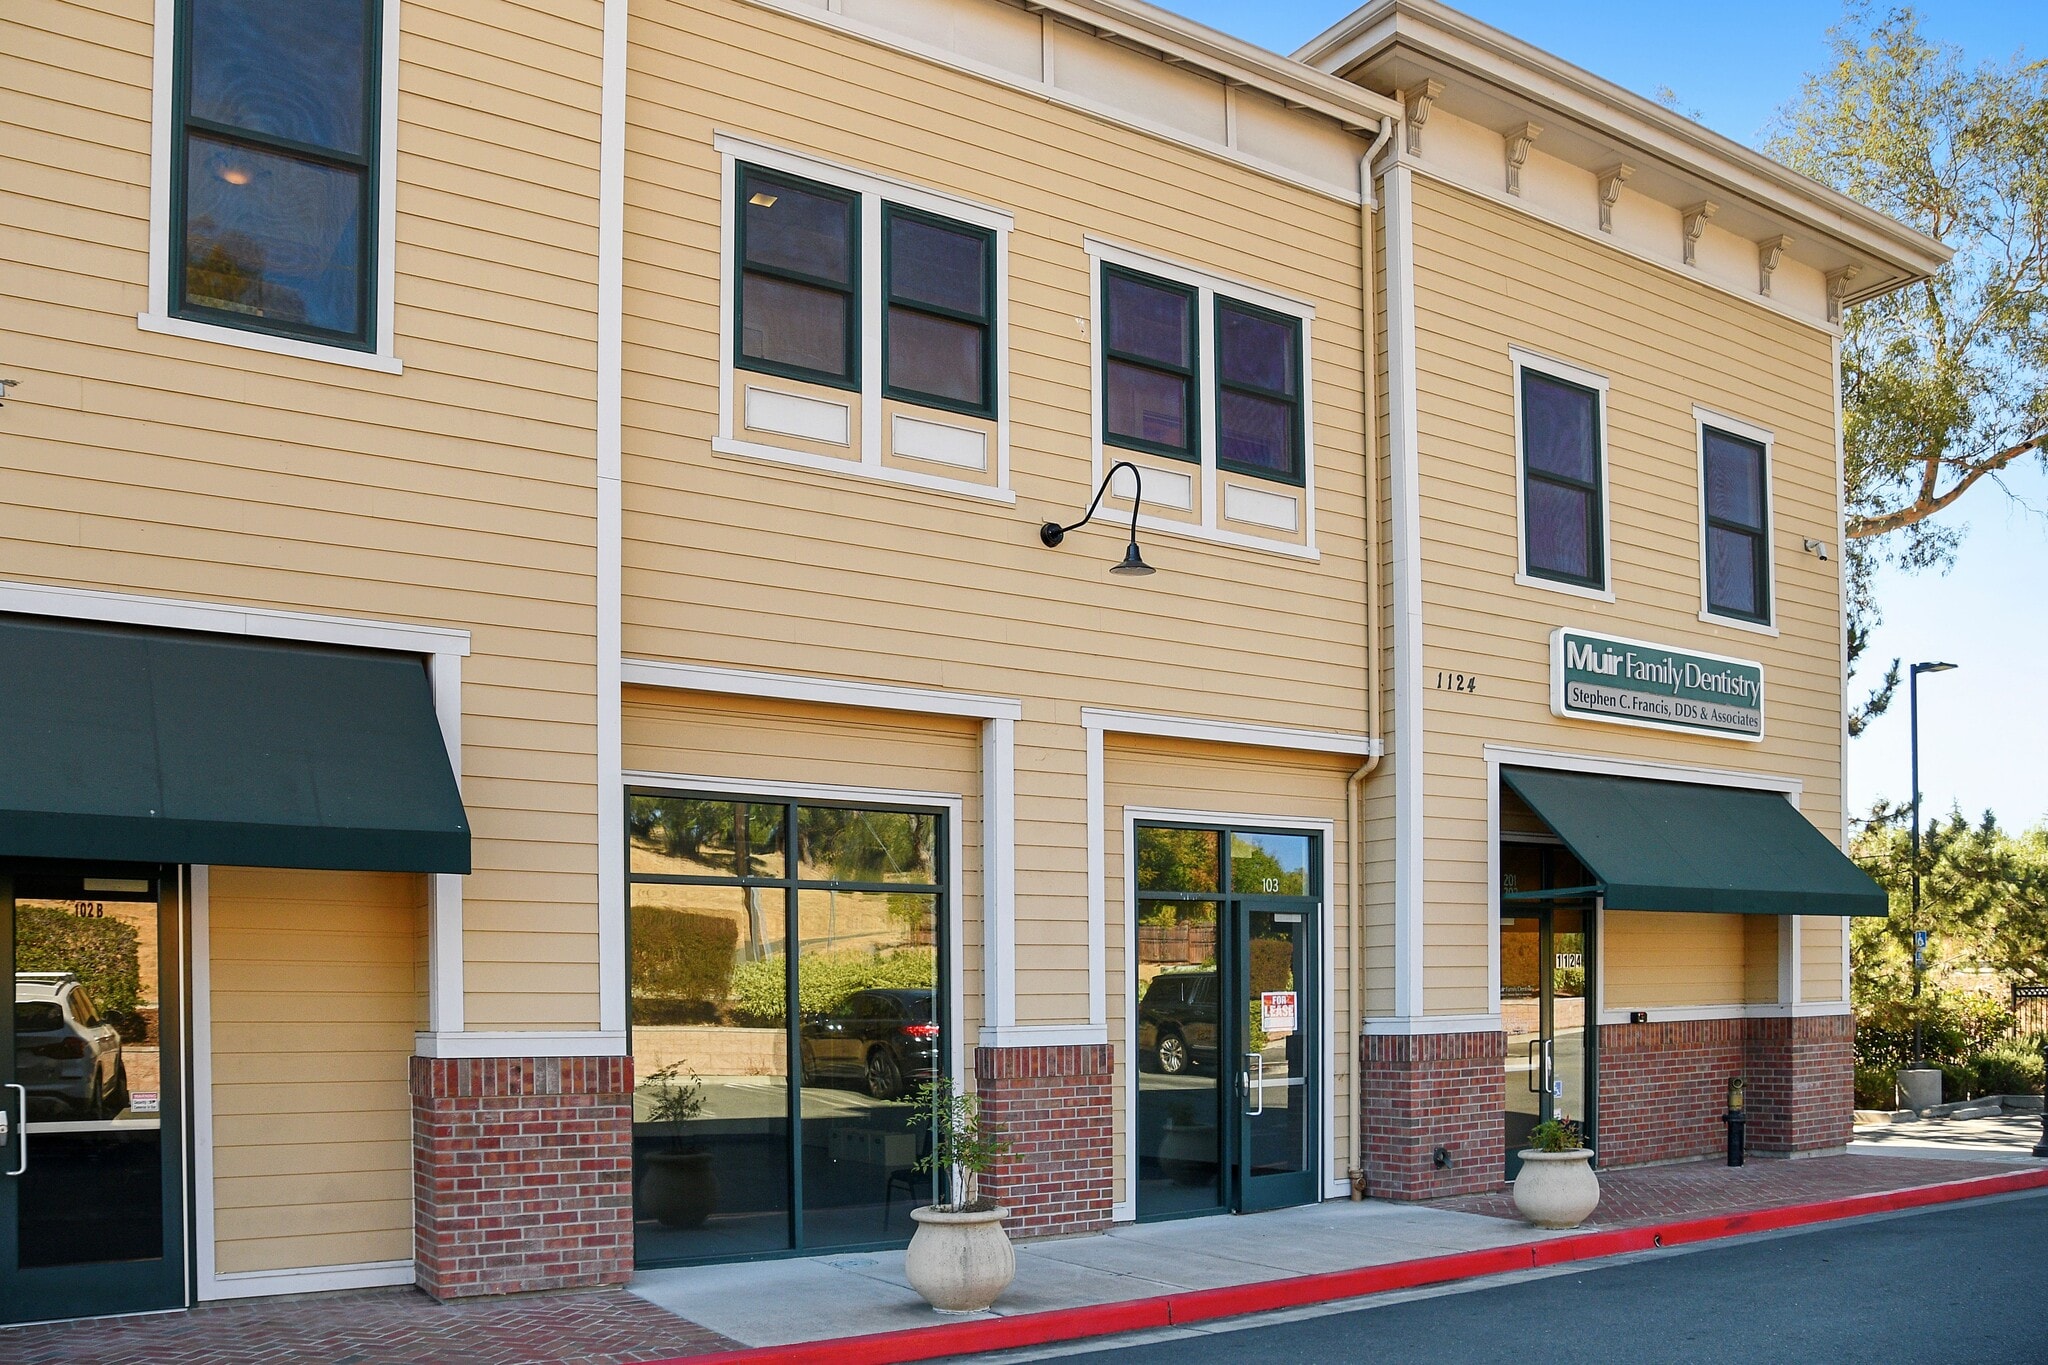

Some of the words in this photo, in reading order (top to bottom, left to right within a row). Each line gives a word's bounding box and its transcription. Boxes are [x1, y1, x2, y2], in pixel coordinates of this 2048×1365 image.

[1567, 640, 1623, 676] Muir
[1625, 651, 1683, 695] Family
[1684, 662, 1760, 707] Dentistry
[1437, 671, 1476, 693] 1124
[1573, 687, 1616, 708] Stephen
[1619, 694, 1630, 709] C.
[1632, 696, 1672, 718] Francis,
[1675, 702, 1698, 719] DDS
[1700, 706, 1708, 720] &
[1710, 708, 1759, 728] Associates
[1262, 877, 1279, 893] 103
[1503, 873, 1517, 886] 201
[74, 902, 94, 918] 102
[96, 903, 104, 918] B
[1557, 954, 1582, 968] 1124
[1272, 995, 1287, 1005] FOR
[1264, 1004, 1294, 1017] LEASE
